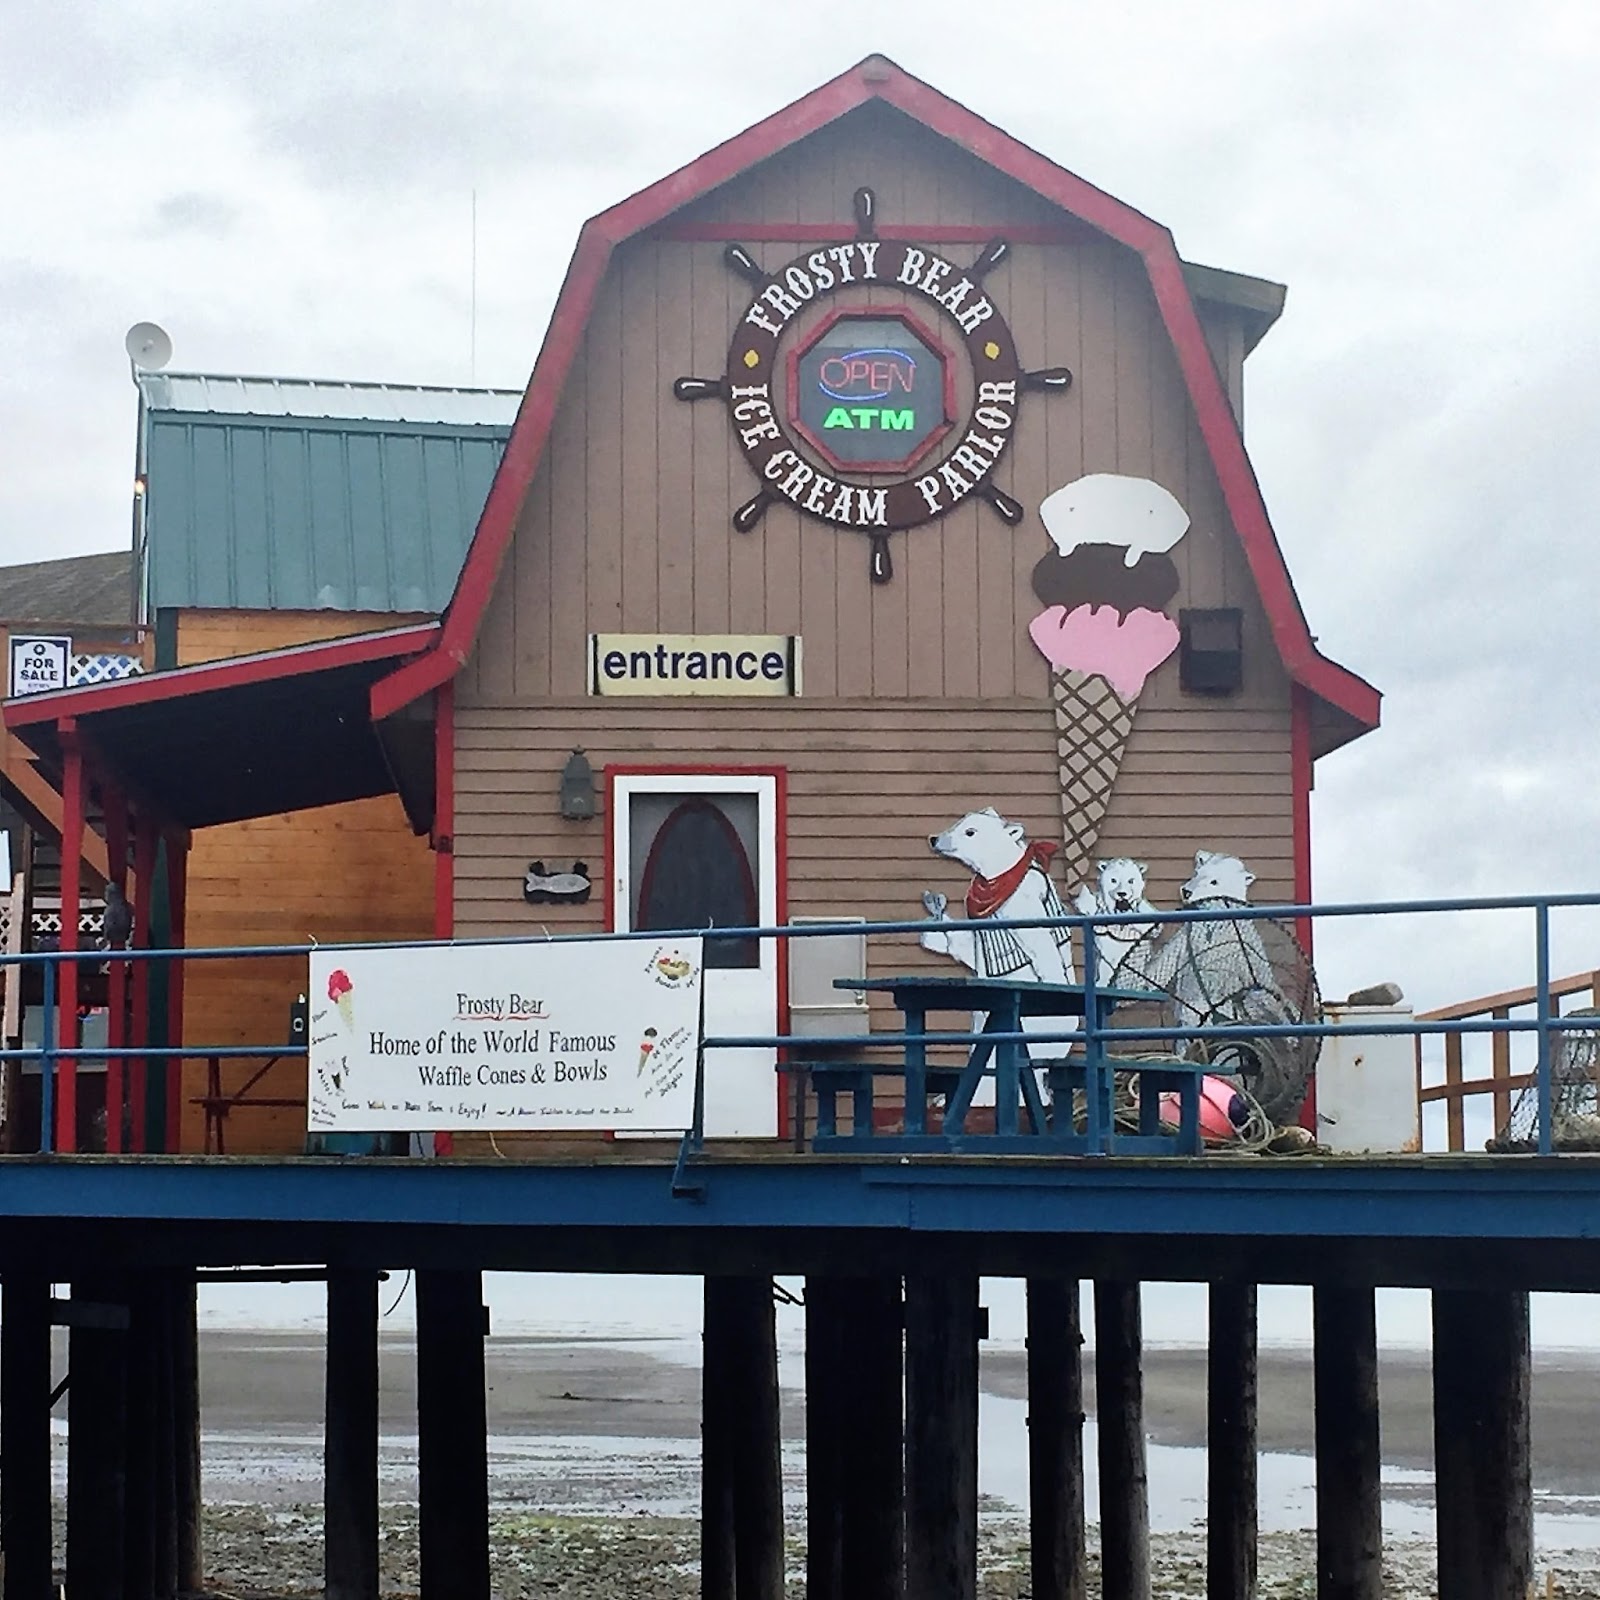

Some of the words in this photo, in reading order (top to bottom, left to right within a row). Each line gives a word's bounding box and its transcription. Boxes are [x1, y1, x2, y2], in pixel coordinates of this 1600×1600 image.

[745, 243, 881, 337] FROSTY
[896, 247, 994, 335] BEAR
[820, 357, 915, 393] OPEN
[823, 407, 915, 431] ATM
[731, 384, 781, 450] ICE
[764, 449, 888, 526] CREAM
[914, 380, 1017, 515] PARLOR
[20, 669, 58, 681] SALE
[24, 657, 54, 669] FOR
[604, 644, 784, 680] entrance
[456, 993, 505, 1020] Frosty
[509, 993, 544, 1015] Bear
[369, 1031, 421, 1056] Home
[426, 1030, 447, 1054] of
[450, 1036, 477, 1054] the
[483, 1029, 540, 1054] World
[549, 1031, 617, 1053] Famous
[418, 1066, 472, 1086] Waffle
[477, 1064, 526, 1086] Cones
[531, 1062, 546, 1084] &
[554, 1059, 608, 1083] Bowls
